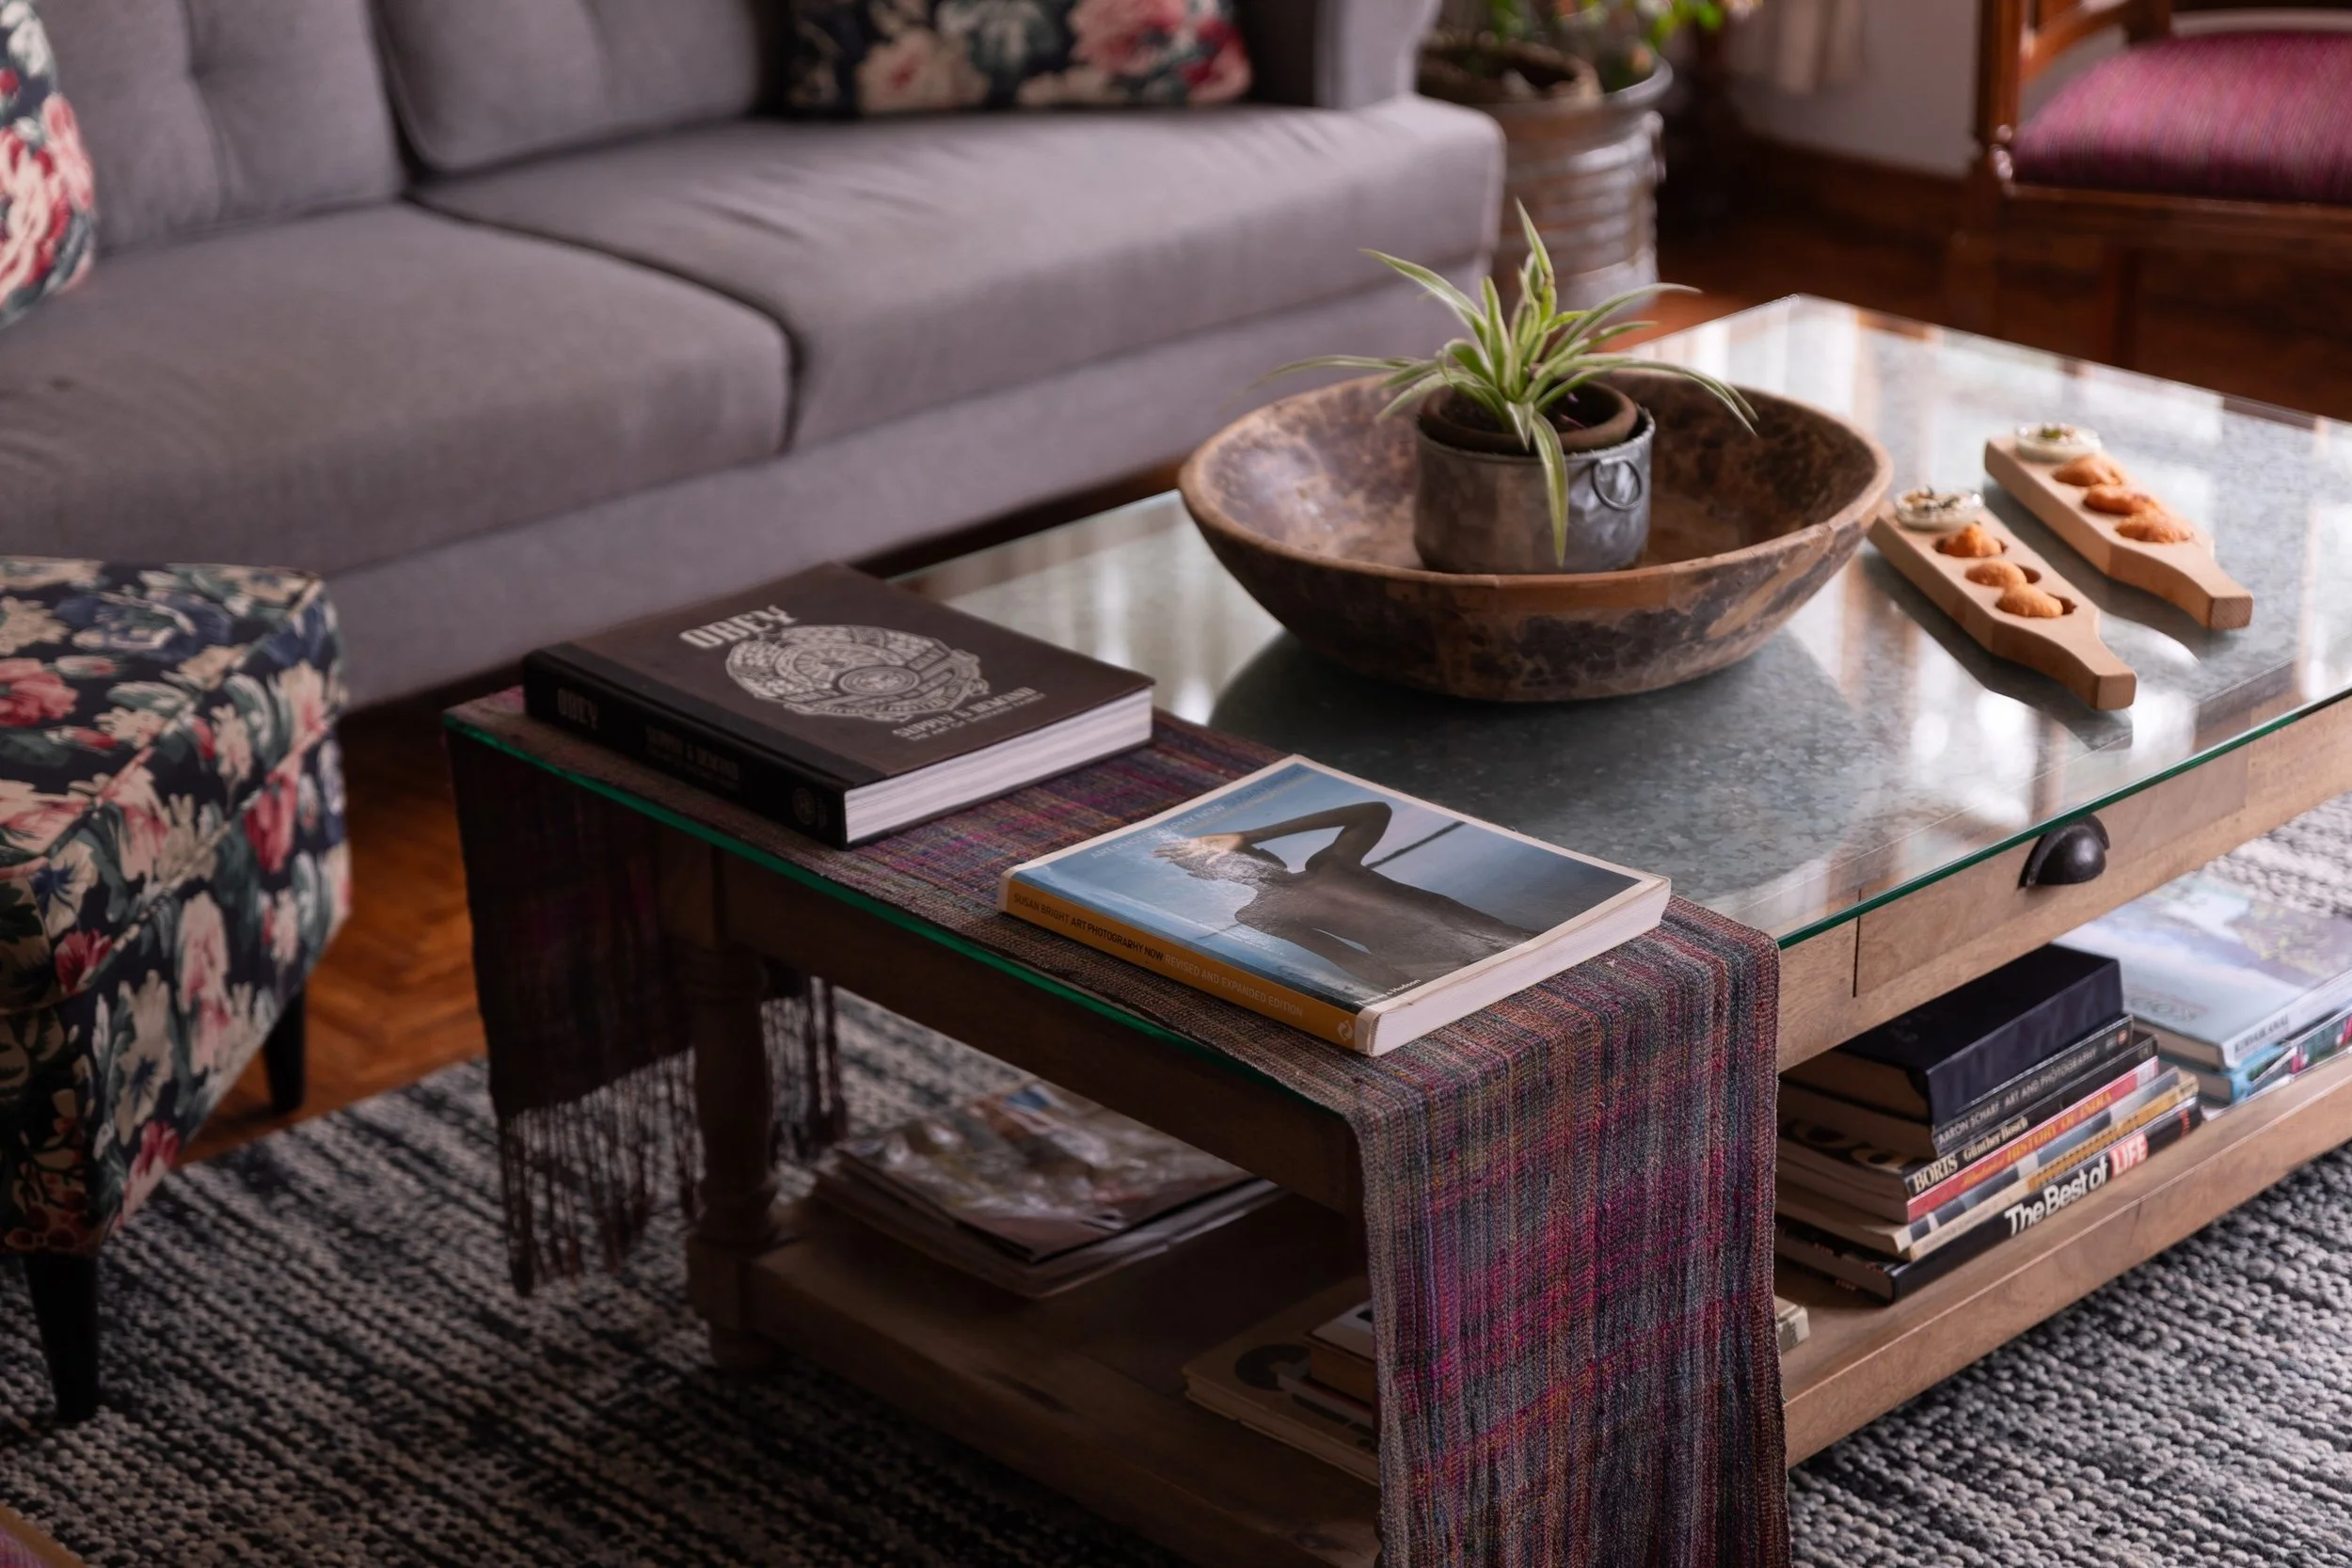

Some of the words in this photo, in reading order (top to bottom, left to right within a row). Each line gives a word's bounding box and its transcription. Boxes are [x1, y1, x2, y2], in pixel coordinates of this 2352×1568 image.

[678, 605, 797, 649] OBEY
[1013, 894, 1040, 911] SUSAN
[1041, 904, 1070, 923] BRIGHT
[1071, 917, 1089, 930] ART
[1087, 925, 1144, 953] PHOTOGRAPHY
[1144, 947, 1164, 961] NOW
[1165, 953, 1200, 976] REVISED
[1200, 970, 1219, 985] AND
[1222, 978, 1266, 1003] EXPANDED
[1268, 995, 1303, 1017] EDITION
[1938, 1120, 1969, 1144] AARON
[1970, 1102, 2000, 1129] SCHARF
[2004, 1091, 2019, 1108] ART
[2022, 1080, 2040, 1098] AND
[2040, 1047, 2096, 1086] PHOTOGRAPHY
[1913, 1153, 1959, 1194] BORIS
[2006, 1124, 2057, 1164] HISTORY
[2004, 1201, 2045, 1237] The
[2042, 1168, 2088, 1215] Best
[2088, 1153, 2108, 1191] of
[2111, 1132, 2148, 1177] LIFE
